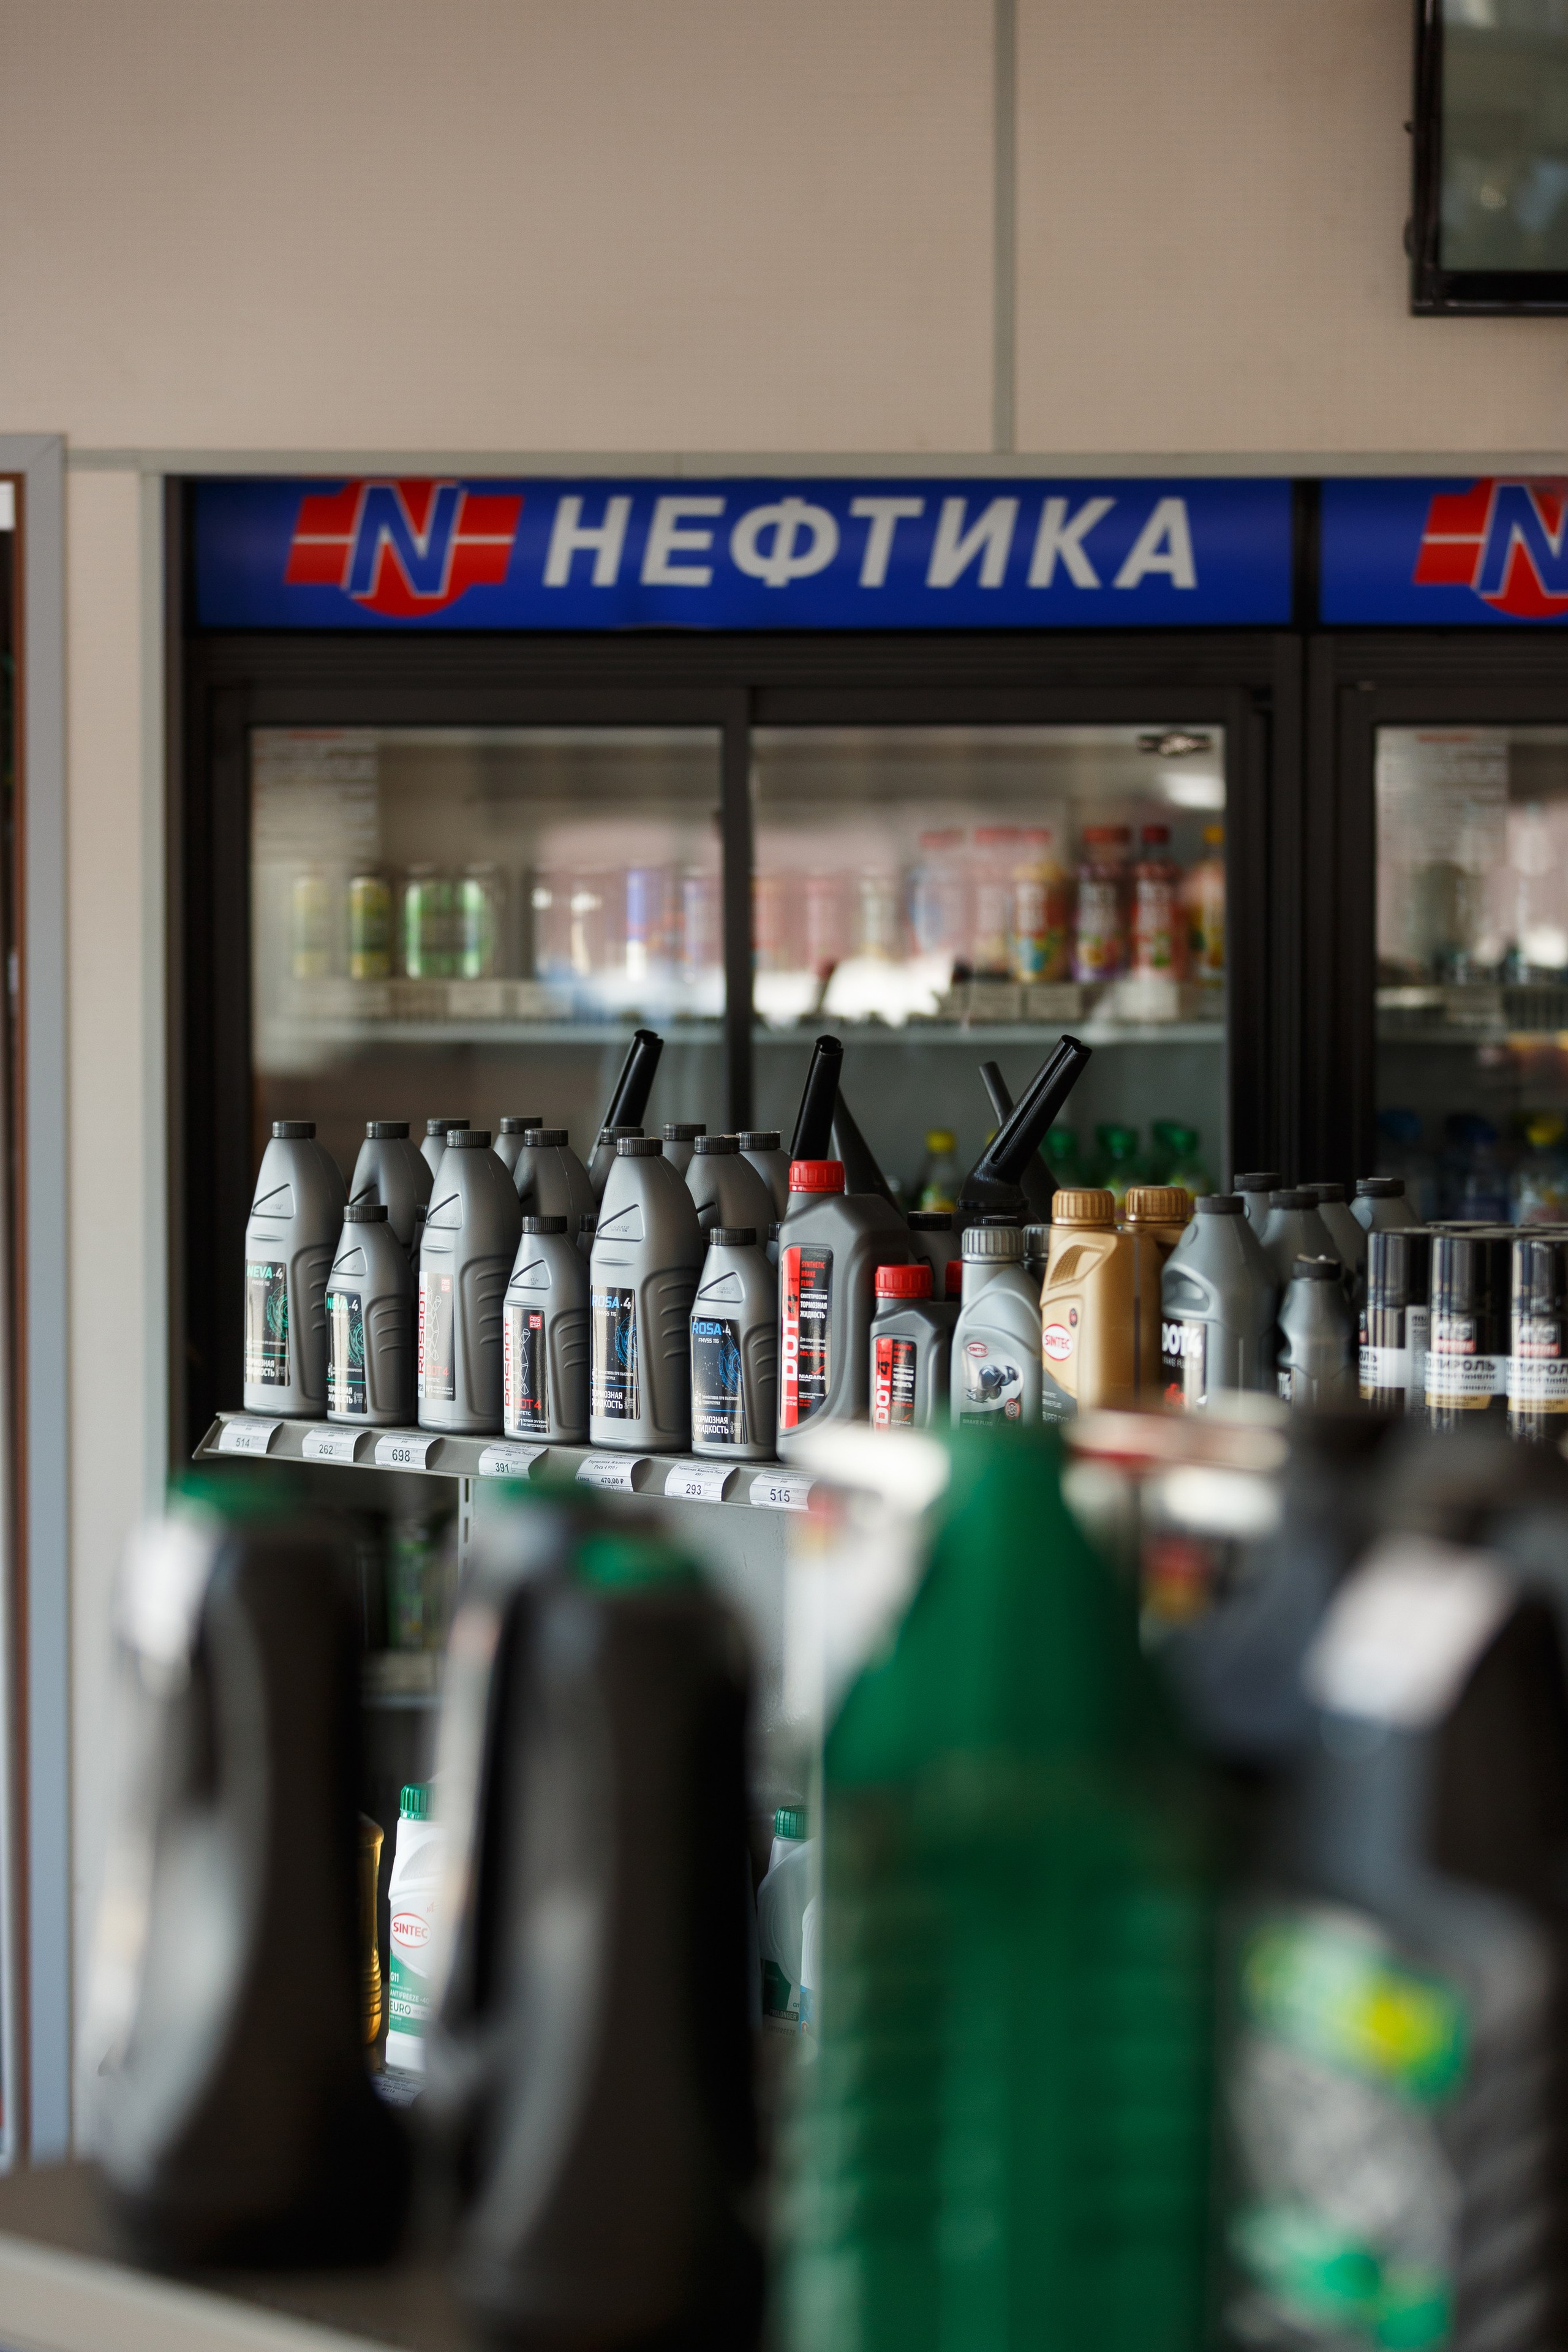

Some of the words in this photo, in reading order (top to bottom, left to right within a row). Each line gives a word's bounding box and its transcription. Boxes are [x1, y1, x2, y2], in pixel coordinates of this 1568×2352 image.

[543, 496, 1197, 588] НЕФТИКА
[800, 1301, 827, 1310] ТОРМОЗНАЯ
[799, 1310, 826, 1319] ЖИДКОСТЬ
[782, 1313, 799, 1382] DOT
[878, 1360, 890, 1376] 4
[592, 1389, 623, 1400] ТОРМОЗНАЯ
[876, 1374, 891, 1424] DOT
[533, 1400, 542, 1410] 4
[592, 1398, 624, 1409] ЖИДКОСТЬ
[695, 1415, 728, 1425] ТОРМОЗНАЯ
[695, 1423, 729, 1434] ЖИДКОСТЬ
[235, 1438, 251, 1448] 514
[318, 1444, 334, 1455] 262
[392, 1449, 410, 1462] 698
[495, 1461, 510, 1473] 391
[685, 1483, 702, 1495] 293
[769, 1488, 791, 1502] 515
[393, 1921, 428, 1939] SINTEC
[390, 1971, 399, 1983] G11
[390, 1989, 420, 2003] ANTIFREEZE
[390, 1999, 411, 2015] EURO
